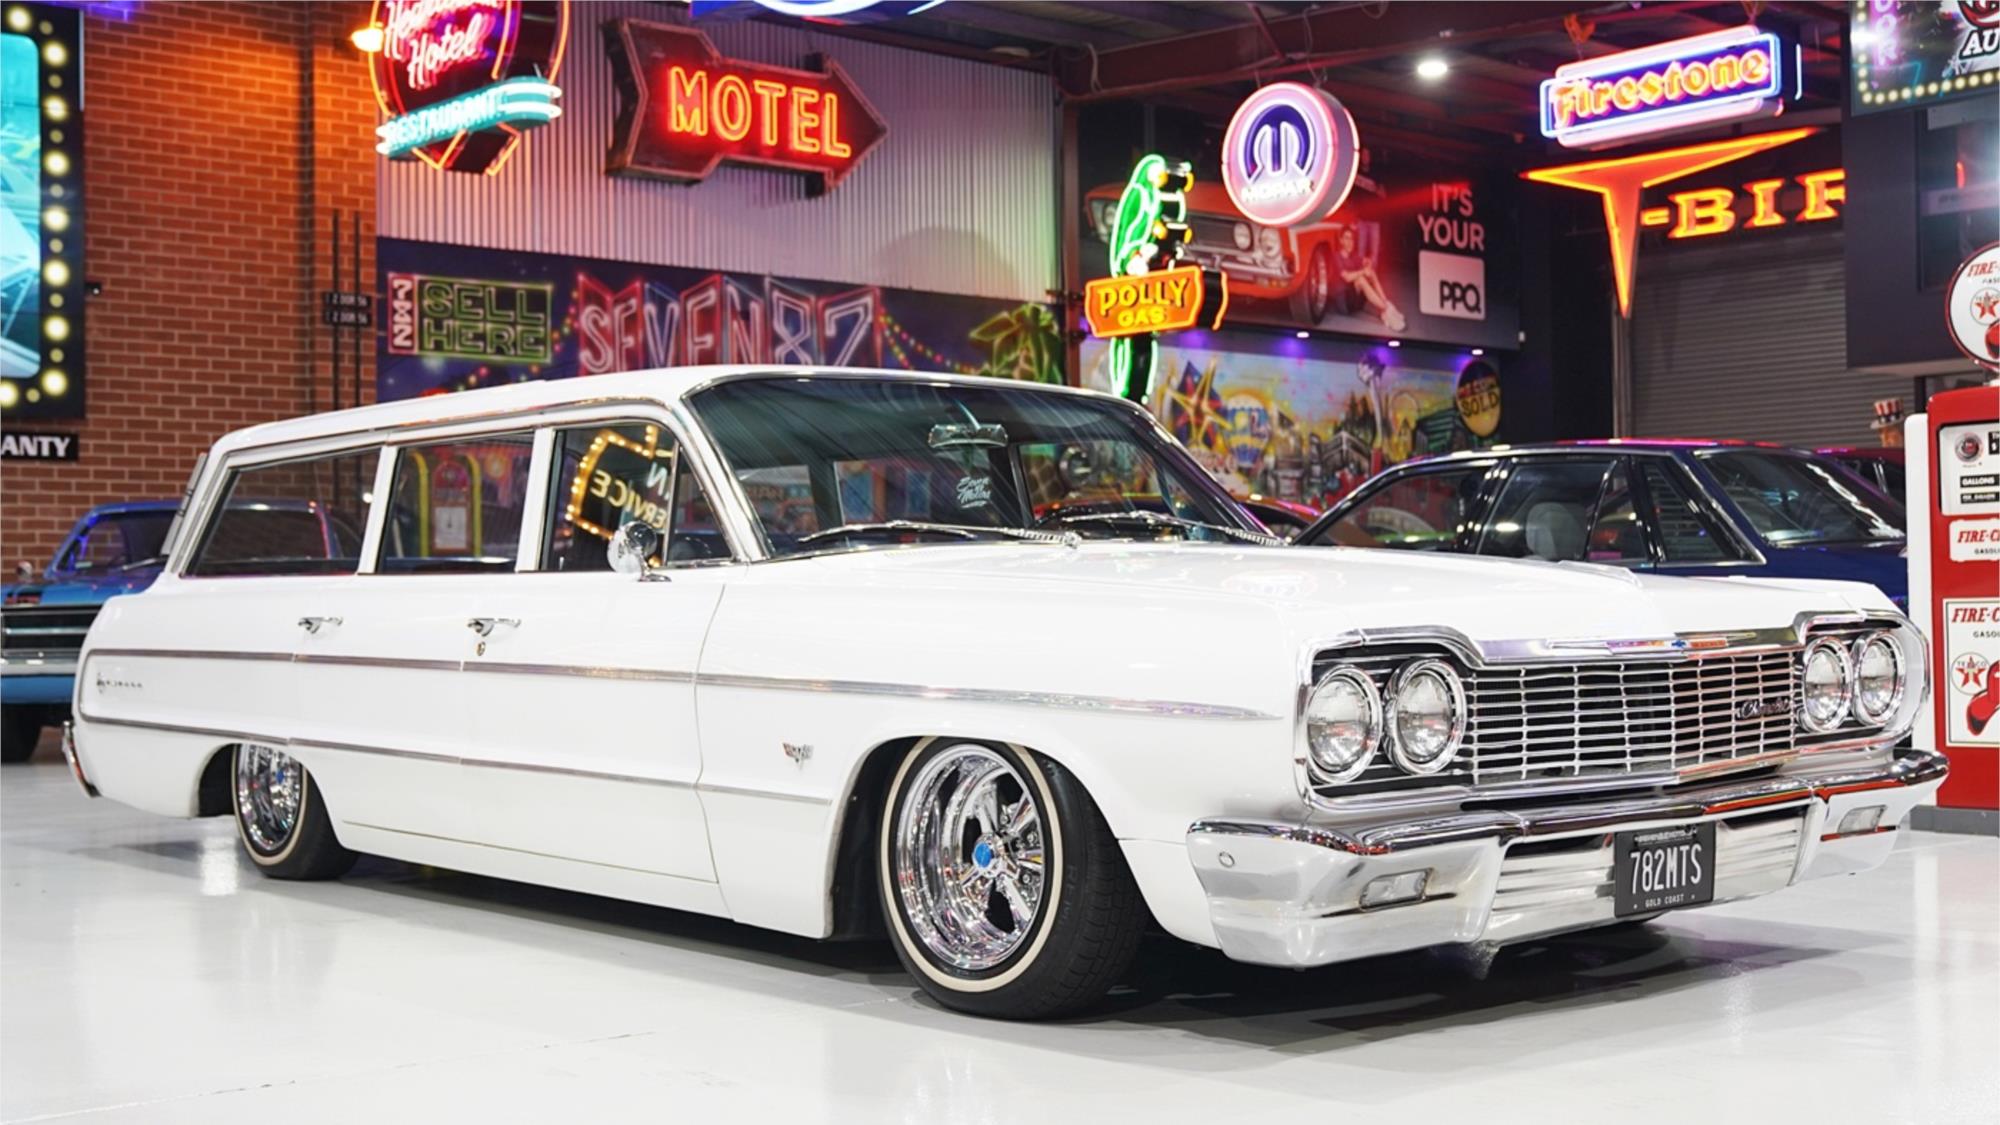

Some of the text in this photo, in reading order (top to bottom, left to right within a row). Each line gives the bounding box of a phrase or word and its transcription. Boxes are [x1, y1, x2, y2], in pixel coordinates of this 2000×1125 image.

[406, 12, 483, 89] Hotel
[1552, 49, 1770, 128] Firestone
[385, 86, 501, 150] RESTAURANT
[670, 66, 851, 158] MOTEL
[1432, 182, 1473, 217] IT'S
[1417, 213, 1485, 252] YOUR
[422, 282, 546, 325] SELL
[1096, 277, 1188, 317] POLLY
[1117, 305, 1165, 327] GAS
[1439, 279, 1482, 314] PPQ
[422, 317, 546, 358] HERE
[1461, 391, 1499, 418] SOLD
[1629, 843, 1703, 895] 782MTS
[1664, 894, 1685, 905] COAST
